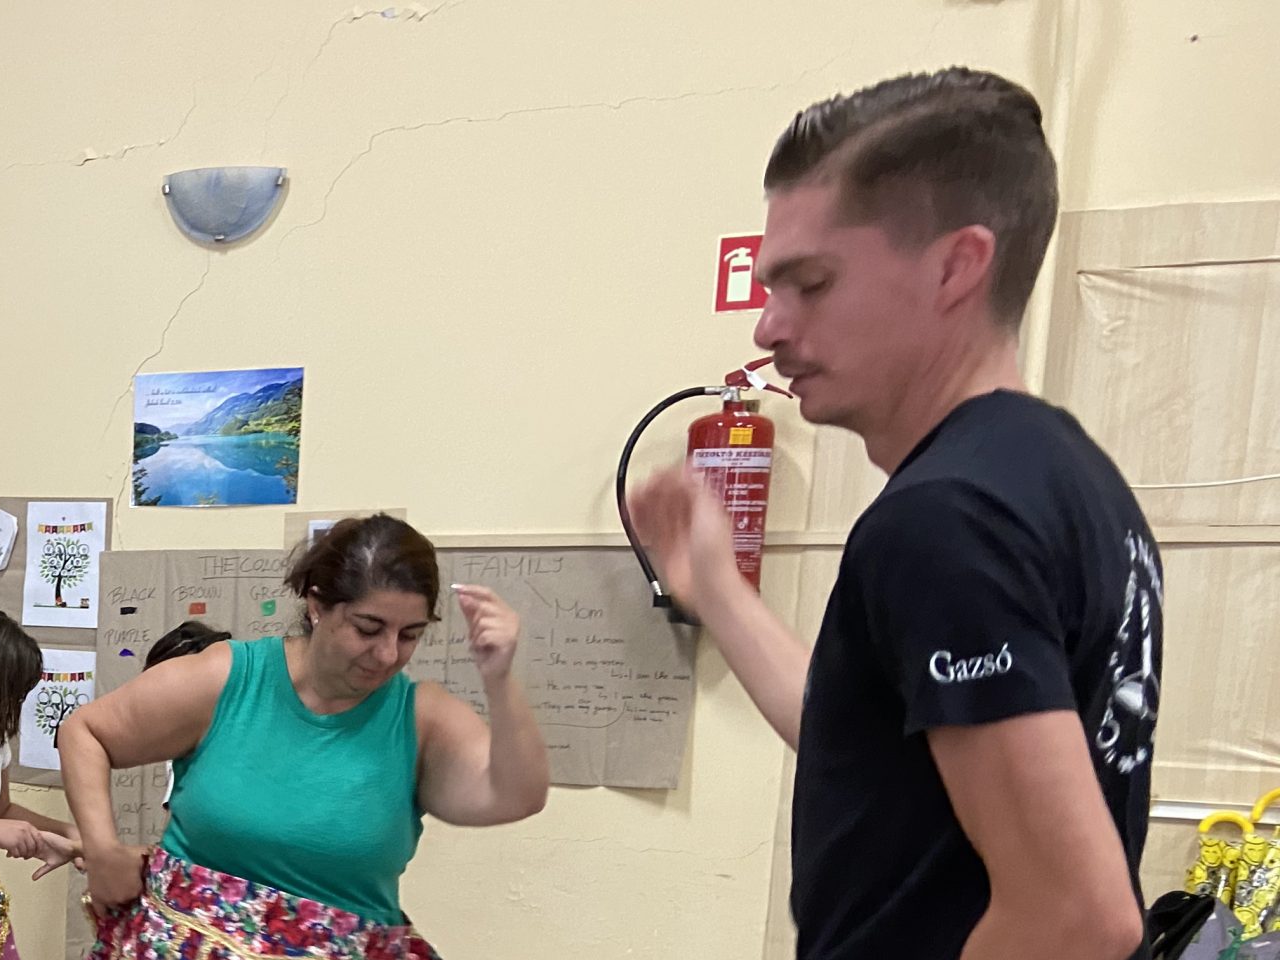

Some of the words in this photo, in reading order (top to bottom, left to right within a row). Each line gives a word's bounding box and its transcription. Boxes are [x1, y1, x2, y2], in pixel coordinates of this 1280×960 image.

[198, 556, 239, 576] THE
[462, 555, 564, 578] FAMILY
[107, 586, 156, 605] BLACK
[170, 585, 223, 602] BROWN
[555, 598, 604, 620] Mom
[104, 628, 150, 646] PURPLE
[546, 652, 568, 666] She
[929, 642, 1012, 683] Gazsó
